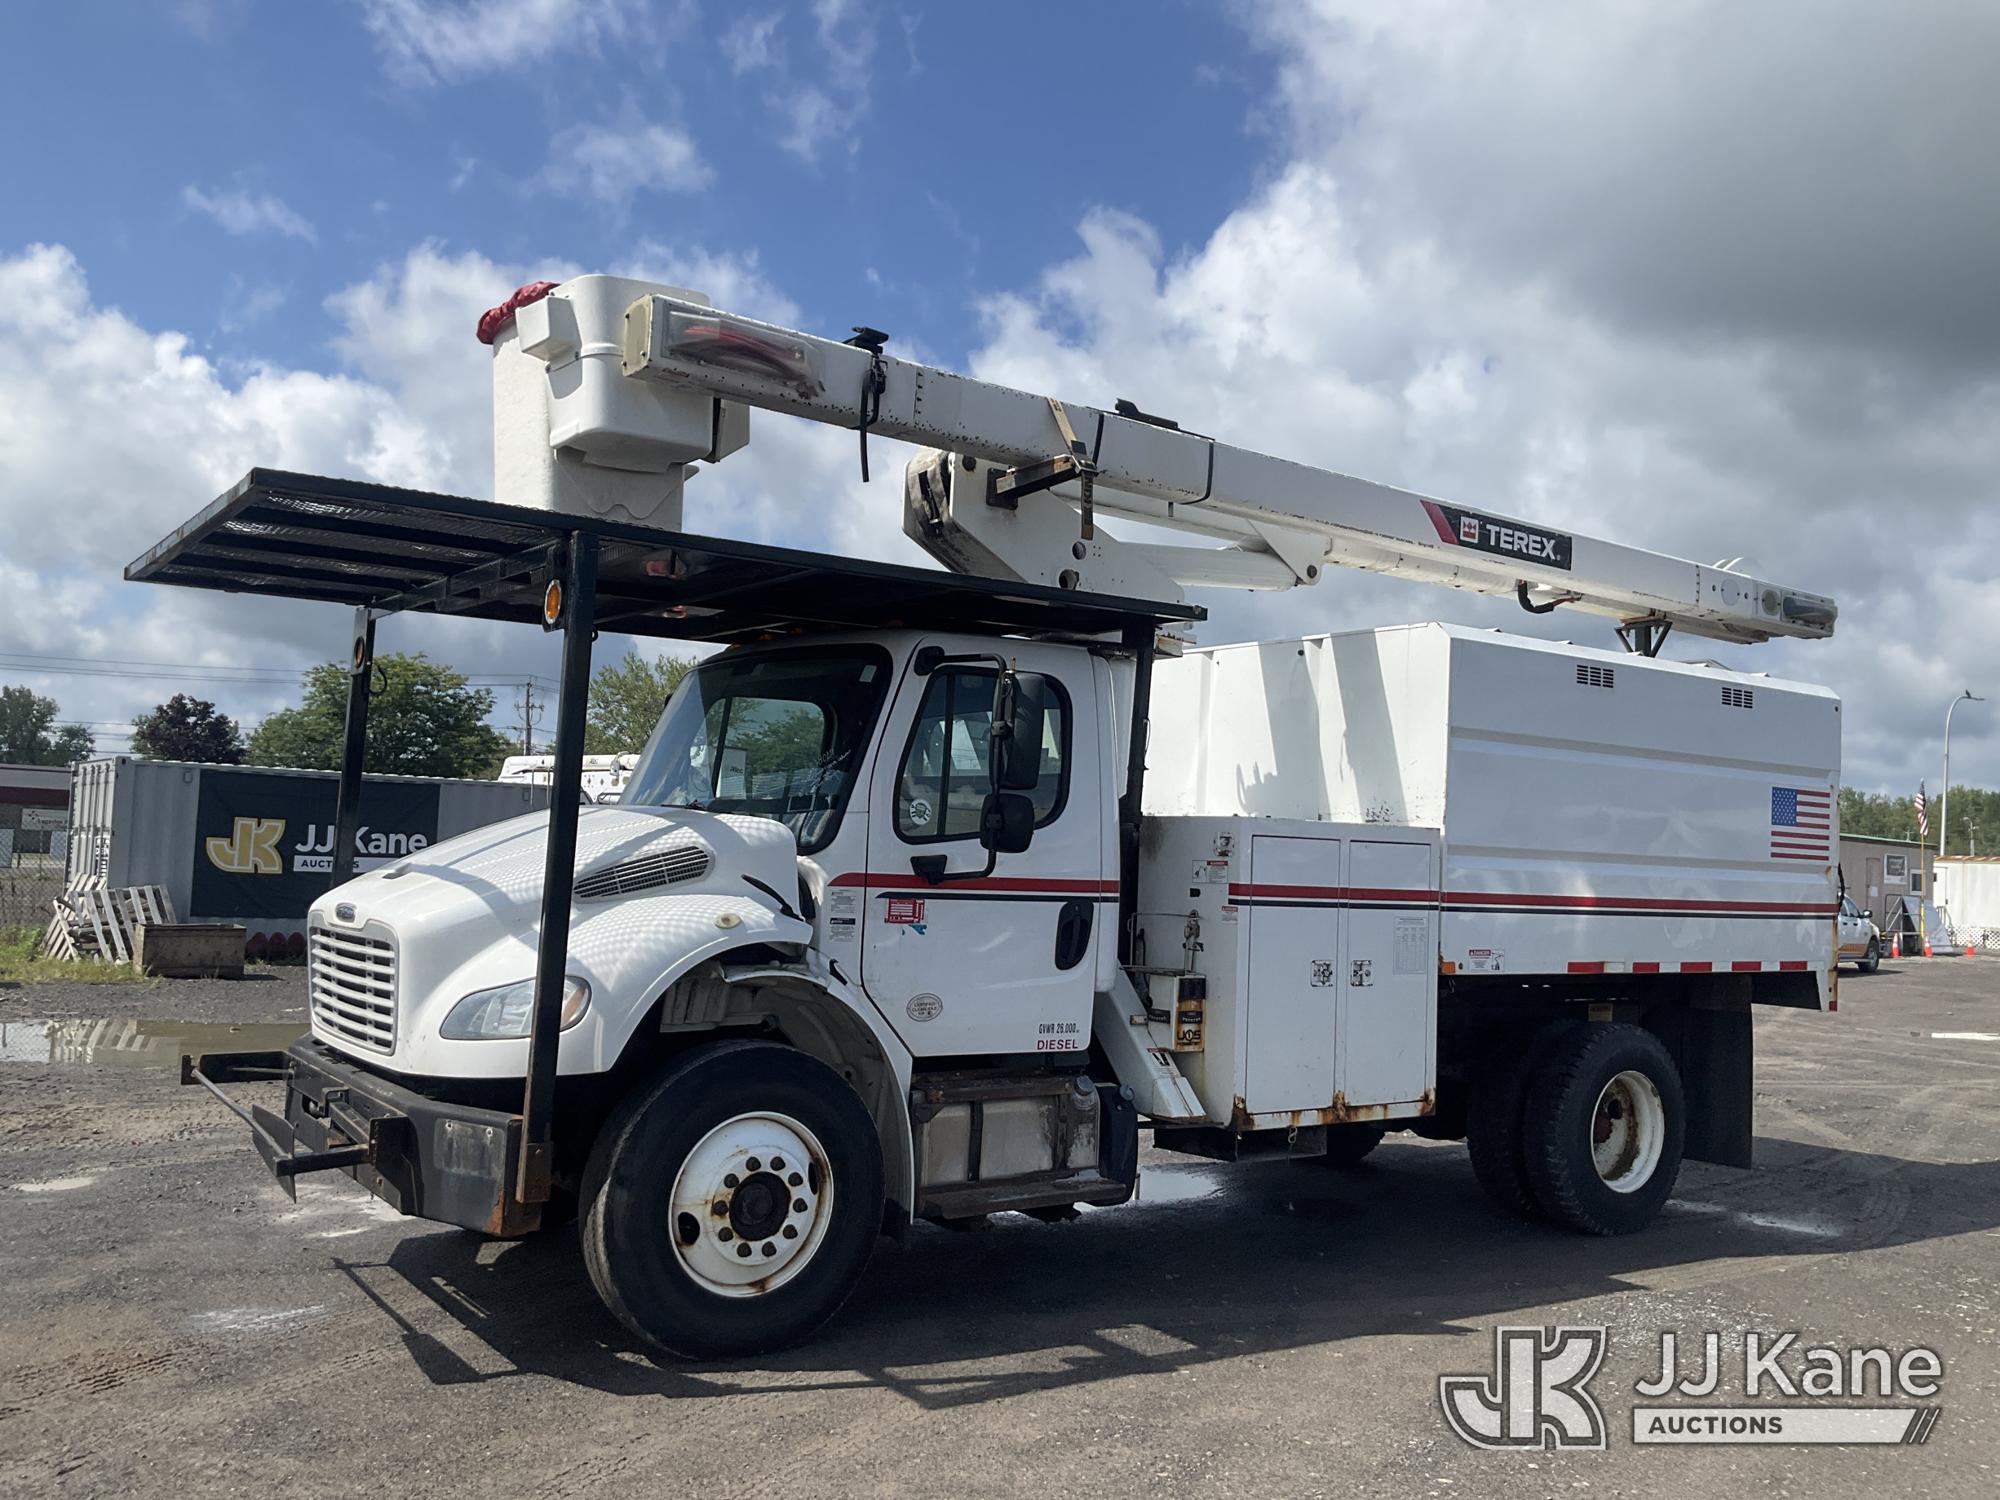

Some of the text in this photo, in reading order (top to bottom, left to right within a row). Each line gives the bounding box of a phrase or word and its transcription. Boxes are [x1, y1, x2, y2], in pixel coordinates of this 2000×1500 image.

[1486, 523, 1556, 561] TEREX
[295, 824, 428, 855] JJ Kane
[301, 859, 359, 869] AUCTS
[1037, 1039, 1079, 1050] DIESEL
